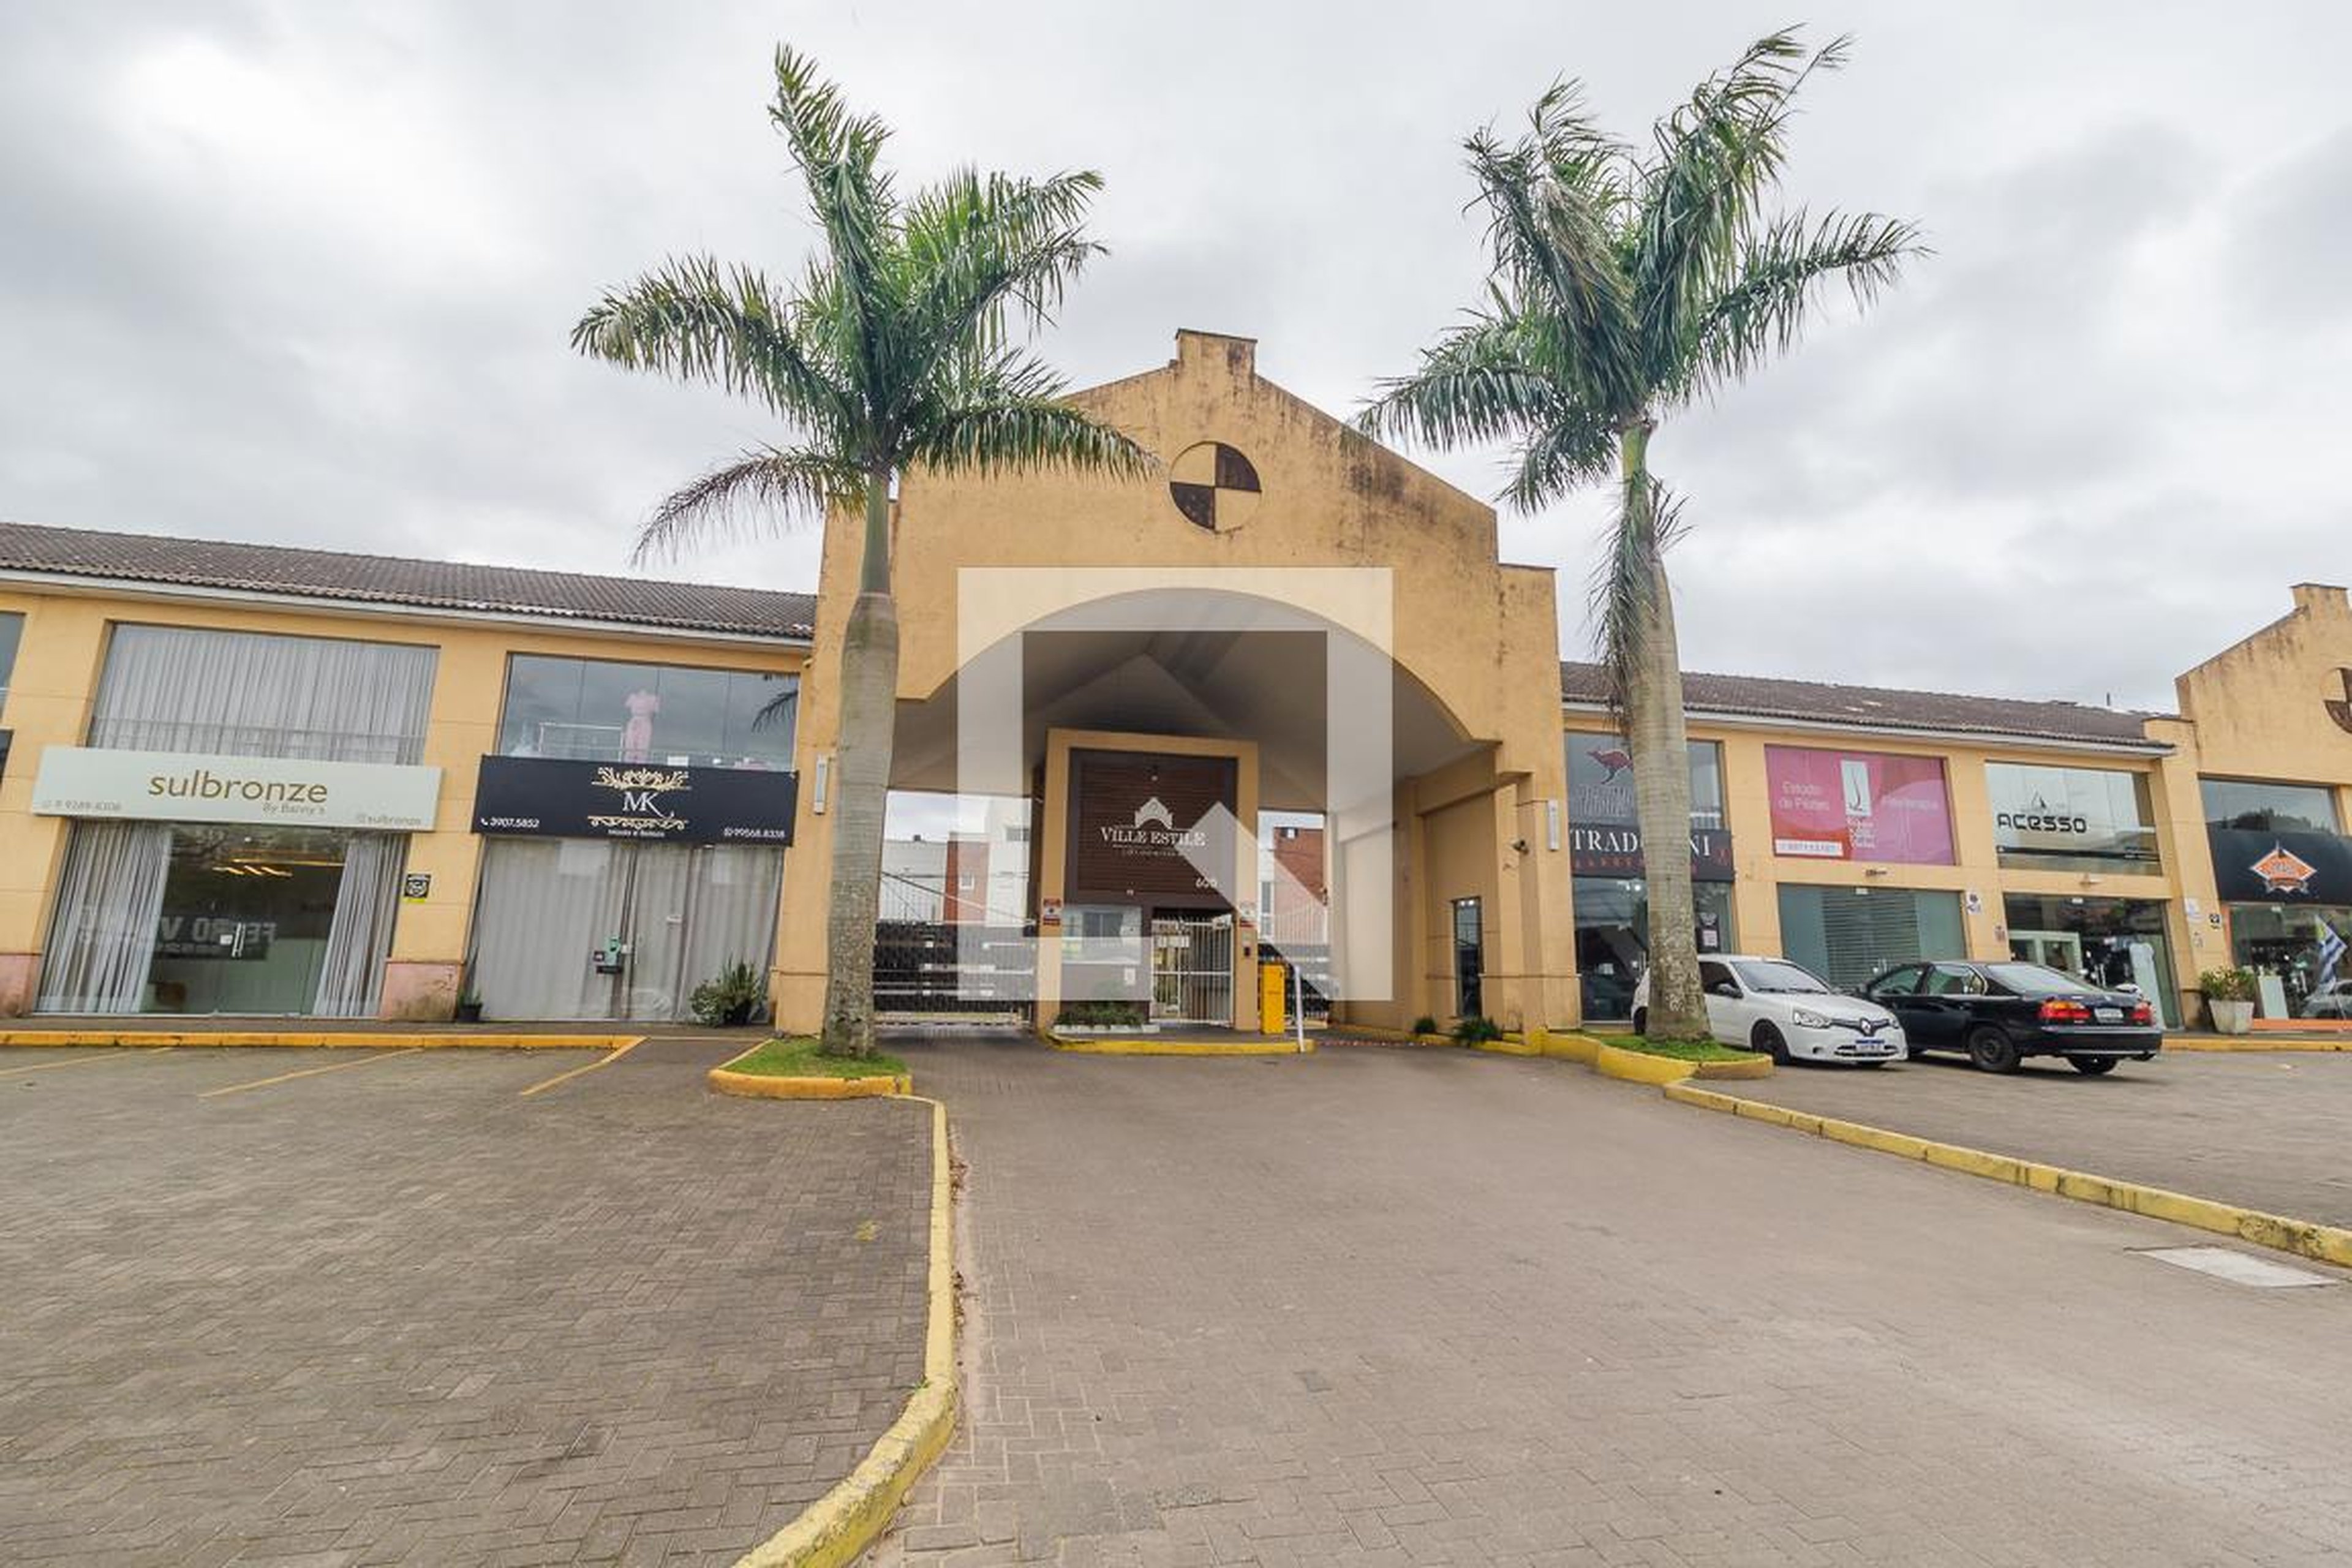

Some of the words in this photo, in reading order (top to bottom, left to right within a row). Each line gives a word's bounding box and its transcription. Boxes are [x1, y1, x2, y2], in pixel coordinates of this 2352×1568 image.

[148, 769, 328, 804] sulbronze
[622, 791, 675, 820] MK
[1100, 826, 1147, 844] VILLE
